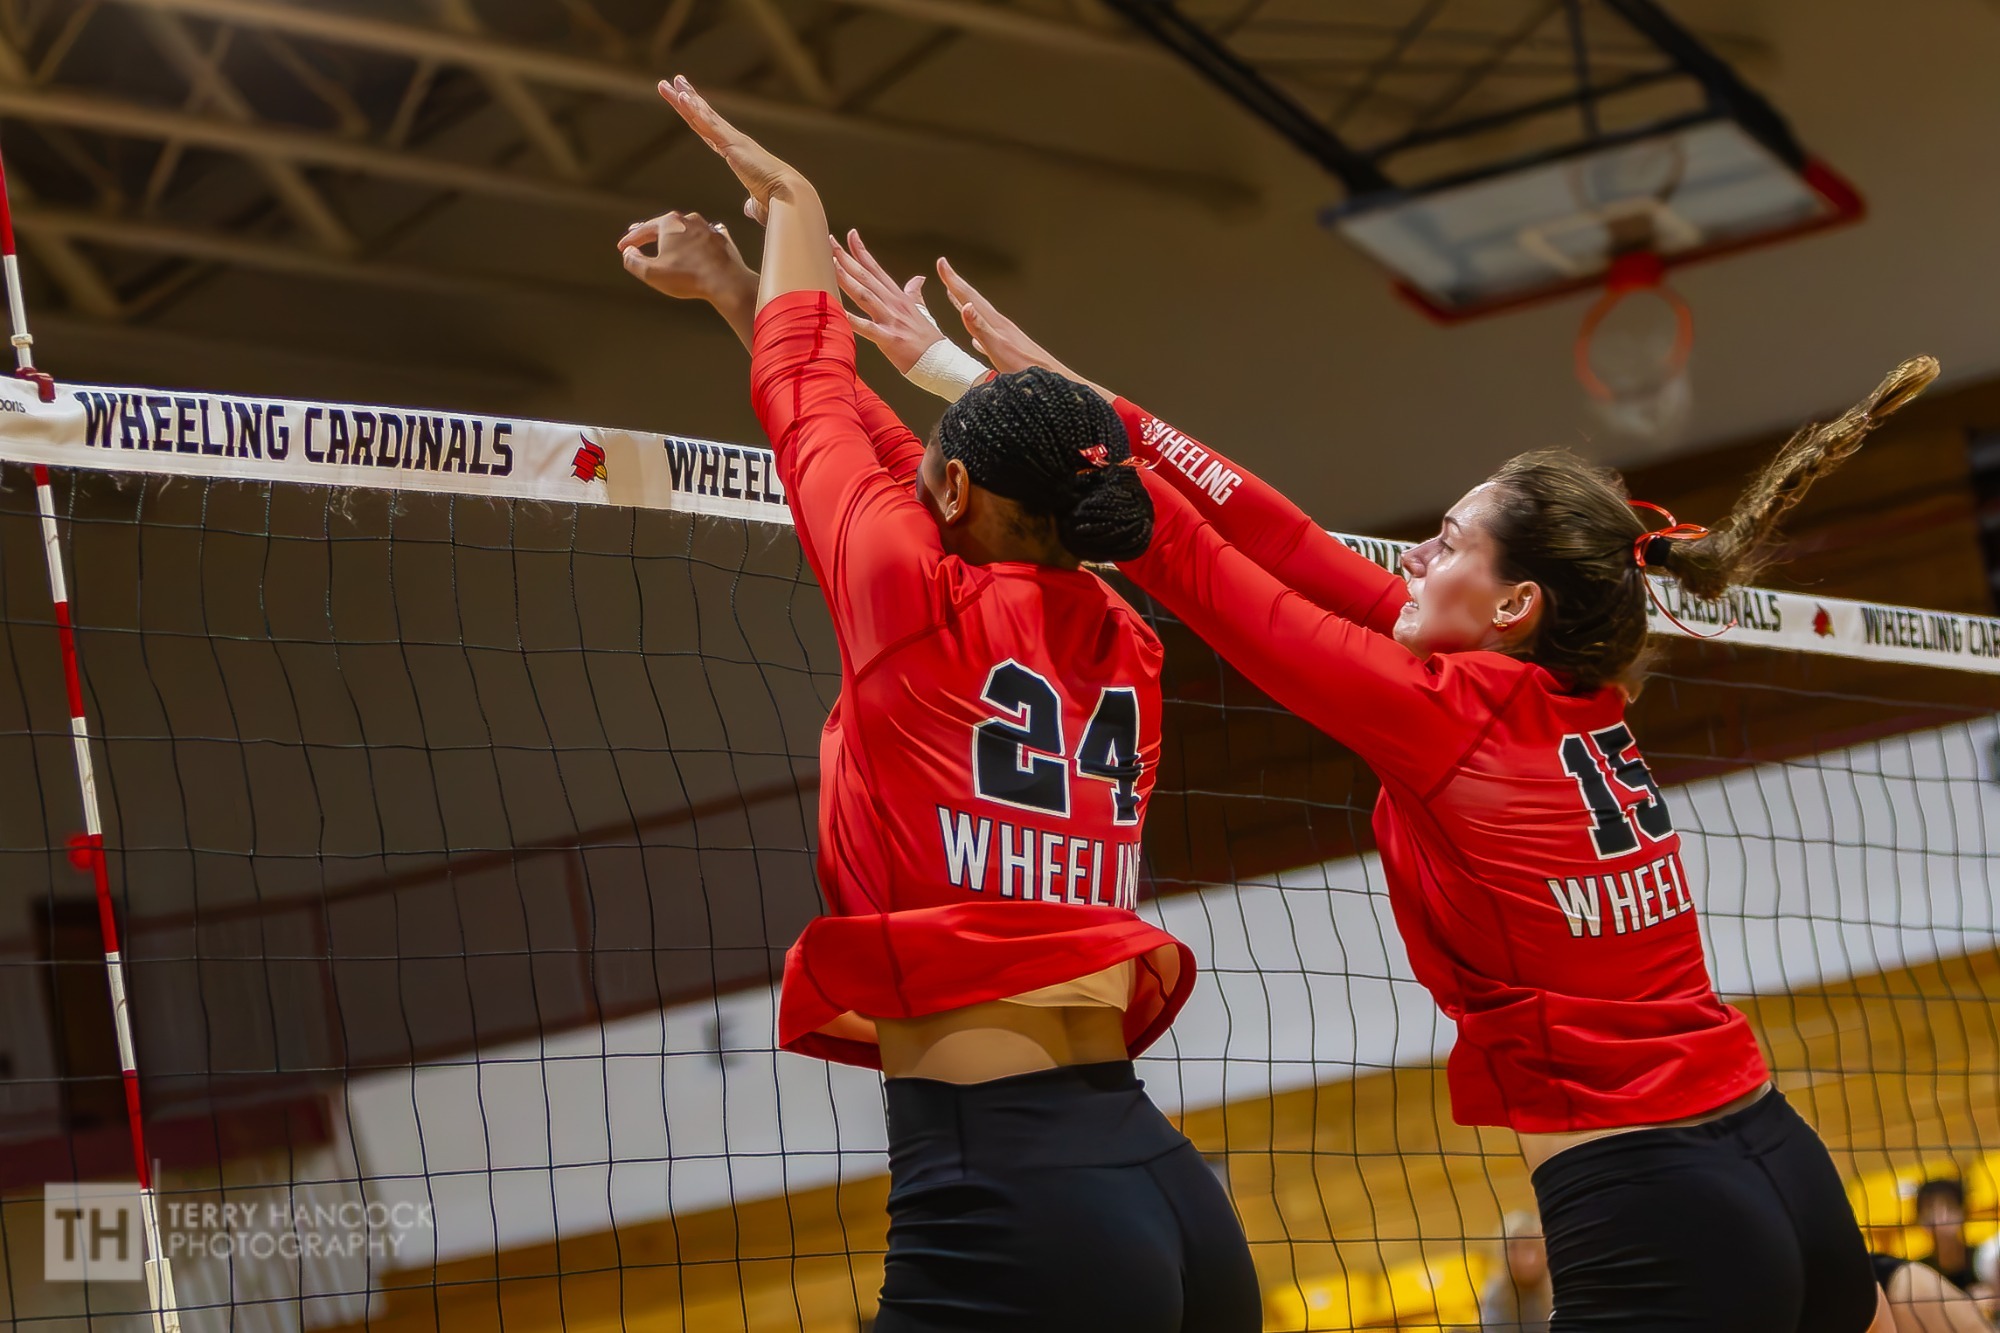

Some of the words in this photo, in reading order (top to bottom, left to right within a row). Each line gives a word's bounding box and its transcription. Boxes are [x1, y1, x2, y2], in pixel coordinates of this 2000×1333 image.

[73, 391, 290, 461] WHEELING
[303, 407, 514, 478] CARDINALS
[663, 439, 788, 506] WHEEL
[1151, 417, 1244, 506] WHEELING
[1861, 607, 1962, 653] WHEELING
[971, 657, 1144, 826] 24
[1558, 721, 1675, 860] 15
[936, 803, 1141, 912] WHEELIN
[1545, 851, 1695, 938] WHEEL
